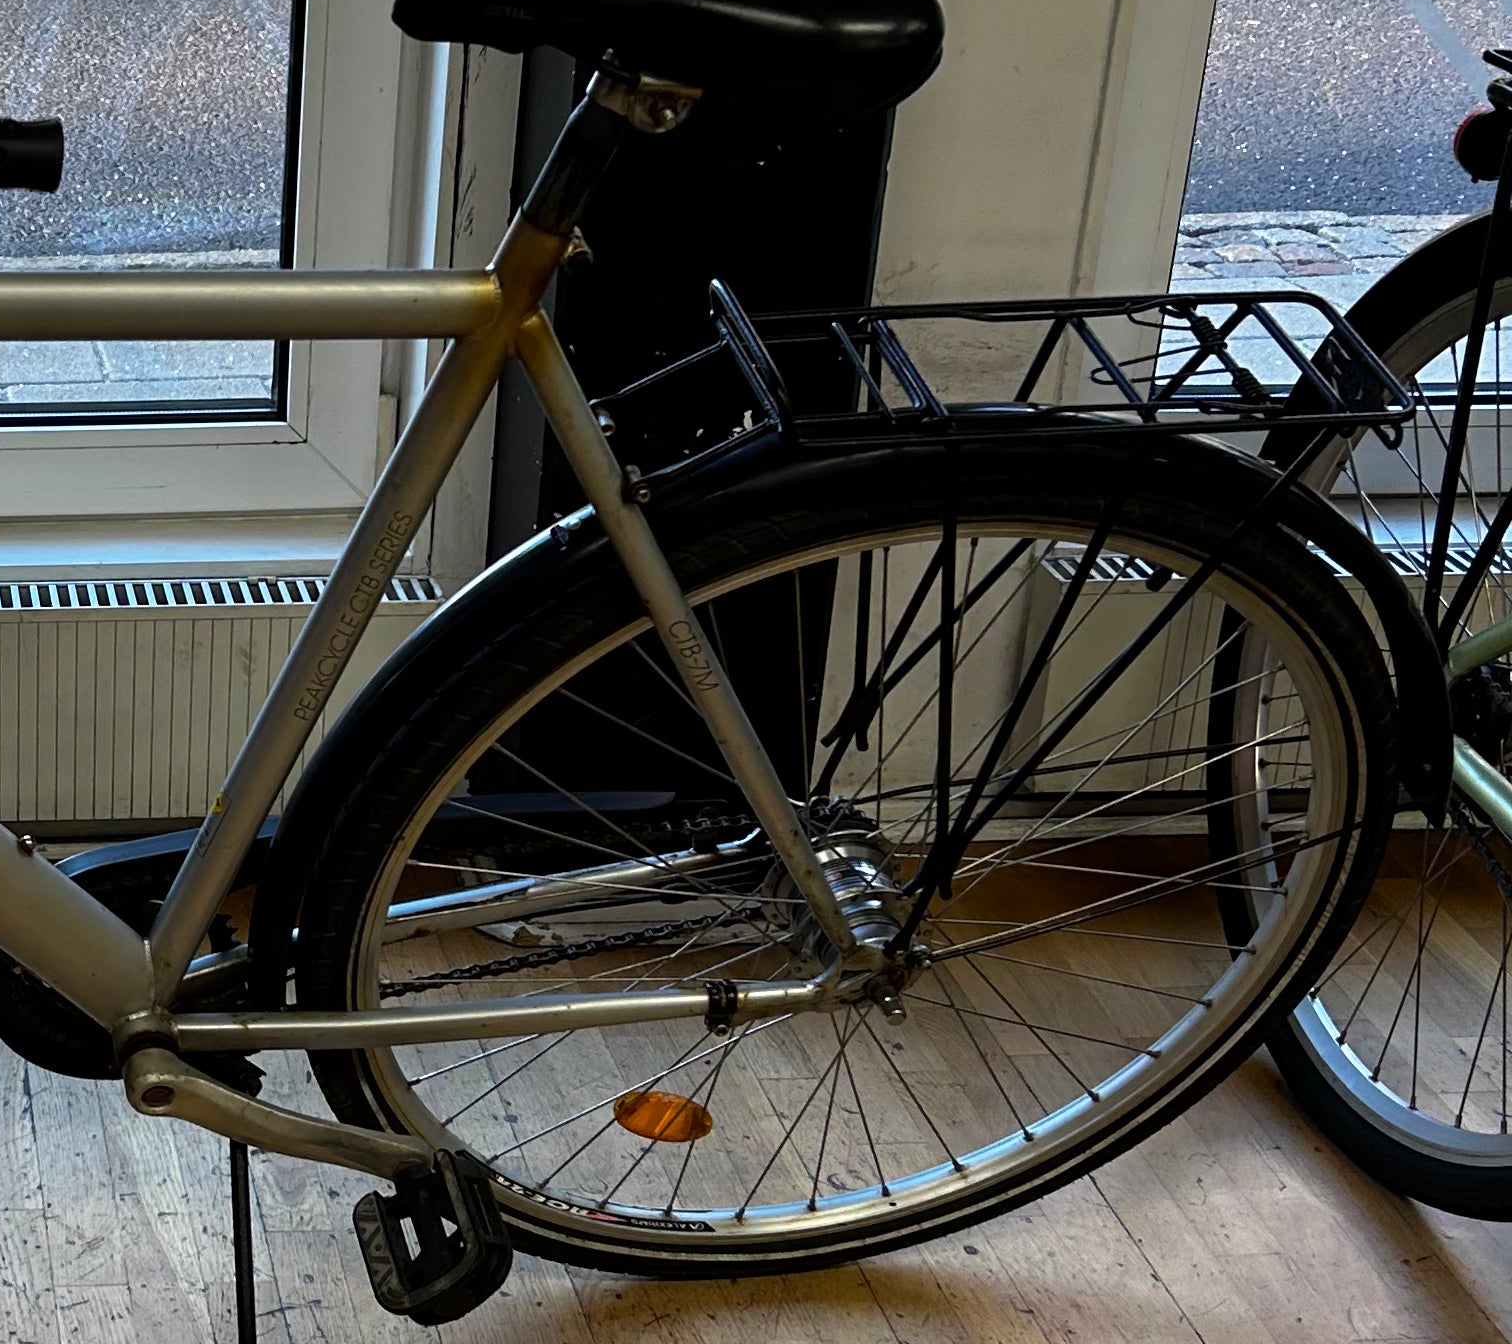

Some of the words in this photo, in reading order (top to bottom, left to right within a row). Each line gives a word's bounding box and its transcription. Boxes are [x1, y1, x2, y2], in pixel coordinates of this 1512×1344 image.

[294, 613, 361, 721] PEAKCYCLE
[349, 575, 380, 614] CTB
[368, 510, 413, 575] SERIES
[669, 619, 719, 692] CTB-7M
